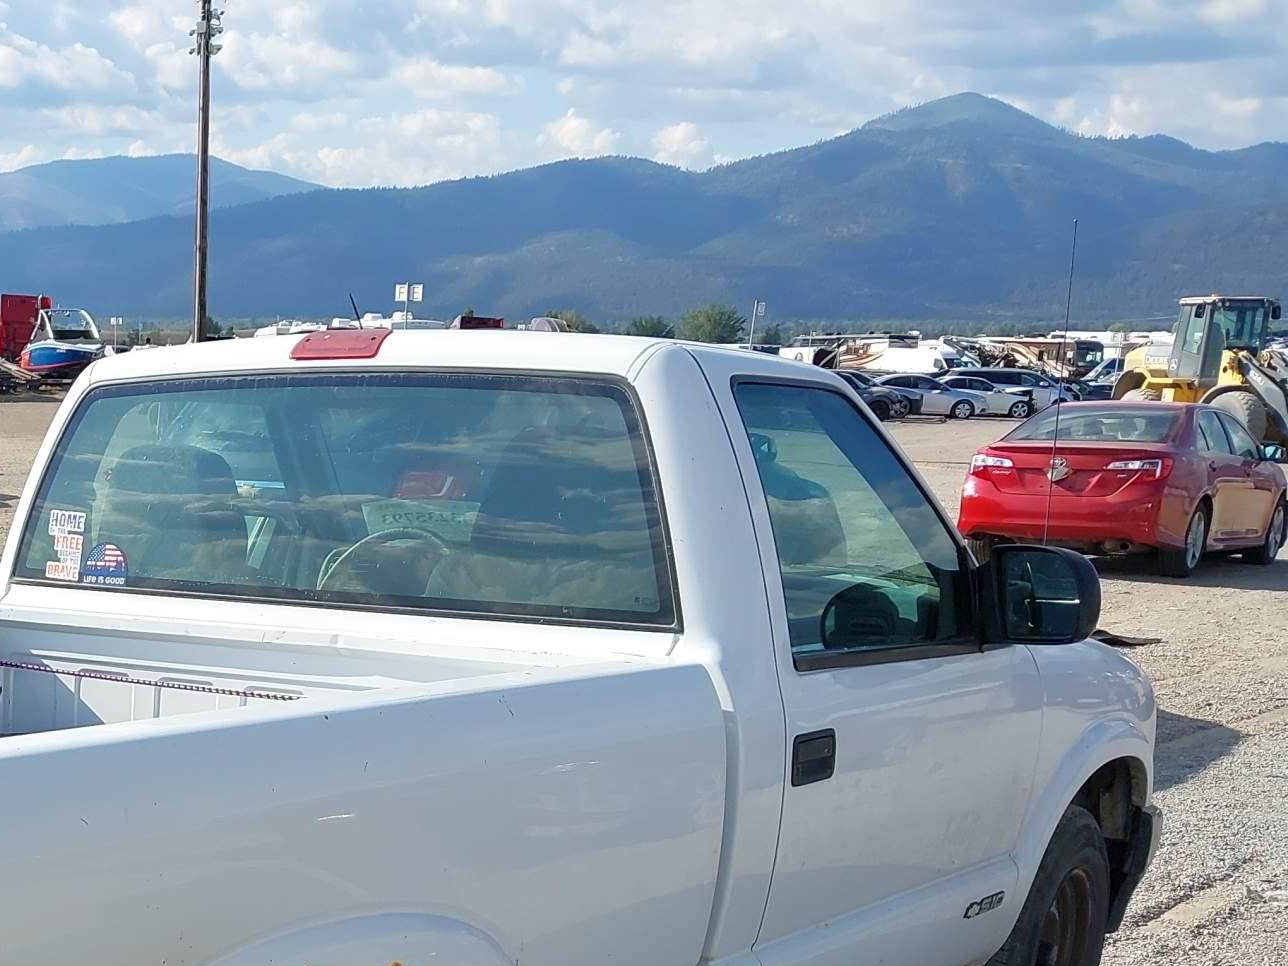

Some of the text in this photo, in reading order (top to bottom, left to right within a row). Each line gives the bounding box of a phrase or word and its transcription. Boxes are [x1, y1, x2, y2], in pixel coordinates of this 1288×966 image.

[398, 286, 420, 299] F E
[52, 512, 84, 529] HOME
[56, 536, 81, 550] FREE
[48, 564, 78, 579] BRAVE
[98, 576, 105, 584] IS
[105, 577, 125, 585] GOOD
